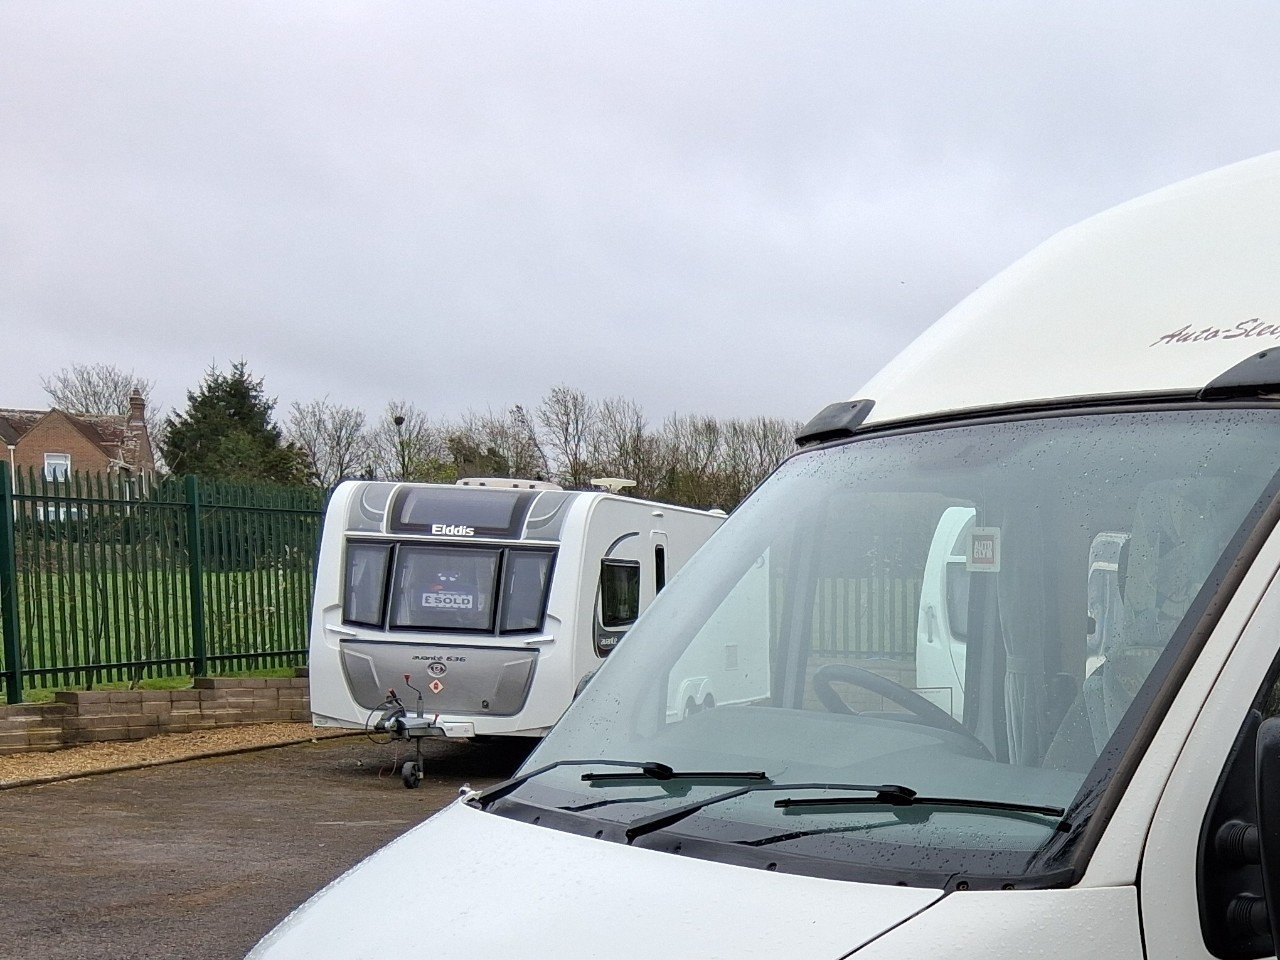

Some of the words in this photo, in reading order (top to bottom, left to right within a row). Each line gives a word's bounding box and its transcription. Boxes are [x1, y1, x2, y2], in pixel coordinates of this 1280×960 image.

[431, 524, 475, 536] Elddis
[974, 540, 993, 550] AUTO
[434, 596, 471, 605] SOLD
